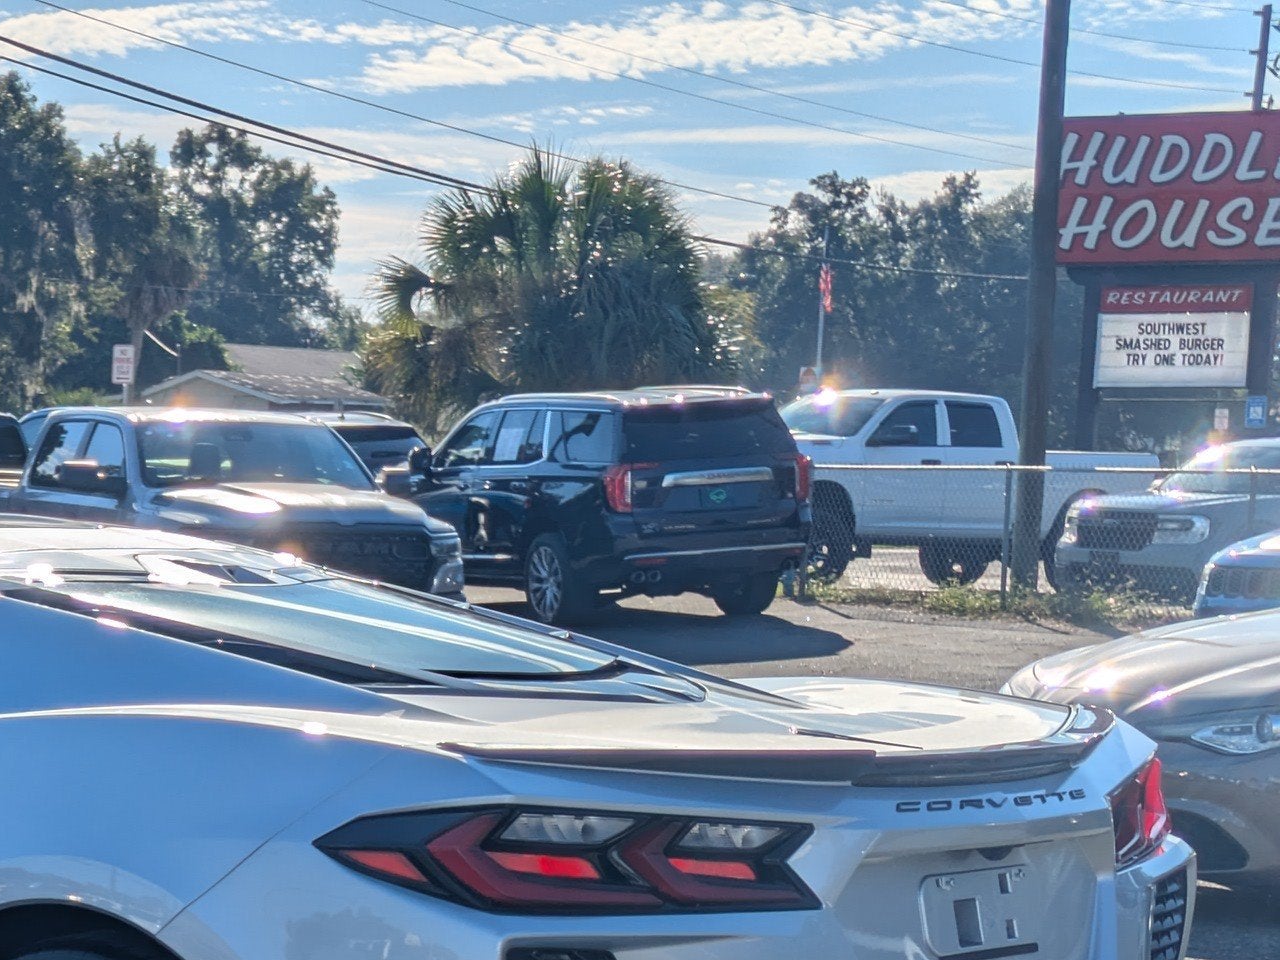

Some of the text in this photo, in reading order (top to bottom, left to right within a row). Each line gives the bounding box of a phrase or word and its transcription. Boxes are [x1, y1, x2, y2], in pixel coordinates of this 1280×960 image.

[1058, 196, 1280, 249] HOUSE
[1106, 288, 1244, 305] RESTAURANT
[1138, 322, 1208, 336] SOUTHWEST
[1116, 338, 1225, 351] SMASHED BURGER
[1126, 353, 1224, 367] TRY ONE TODAY!
[895, 788, 1087, 813] CORVETTE
